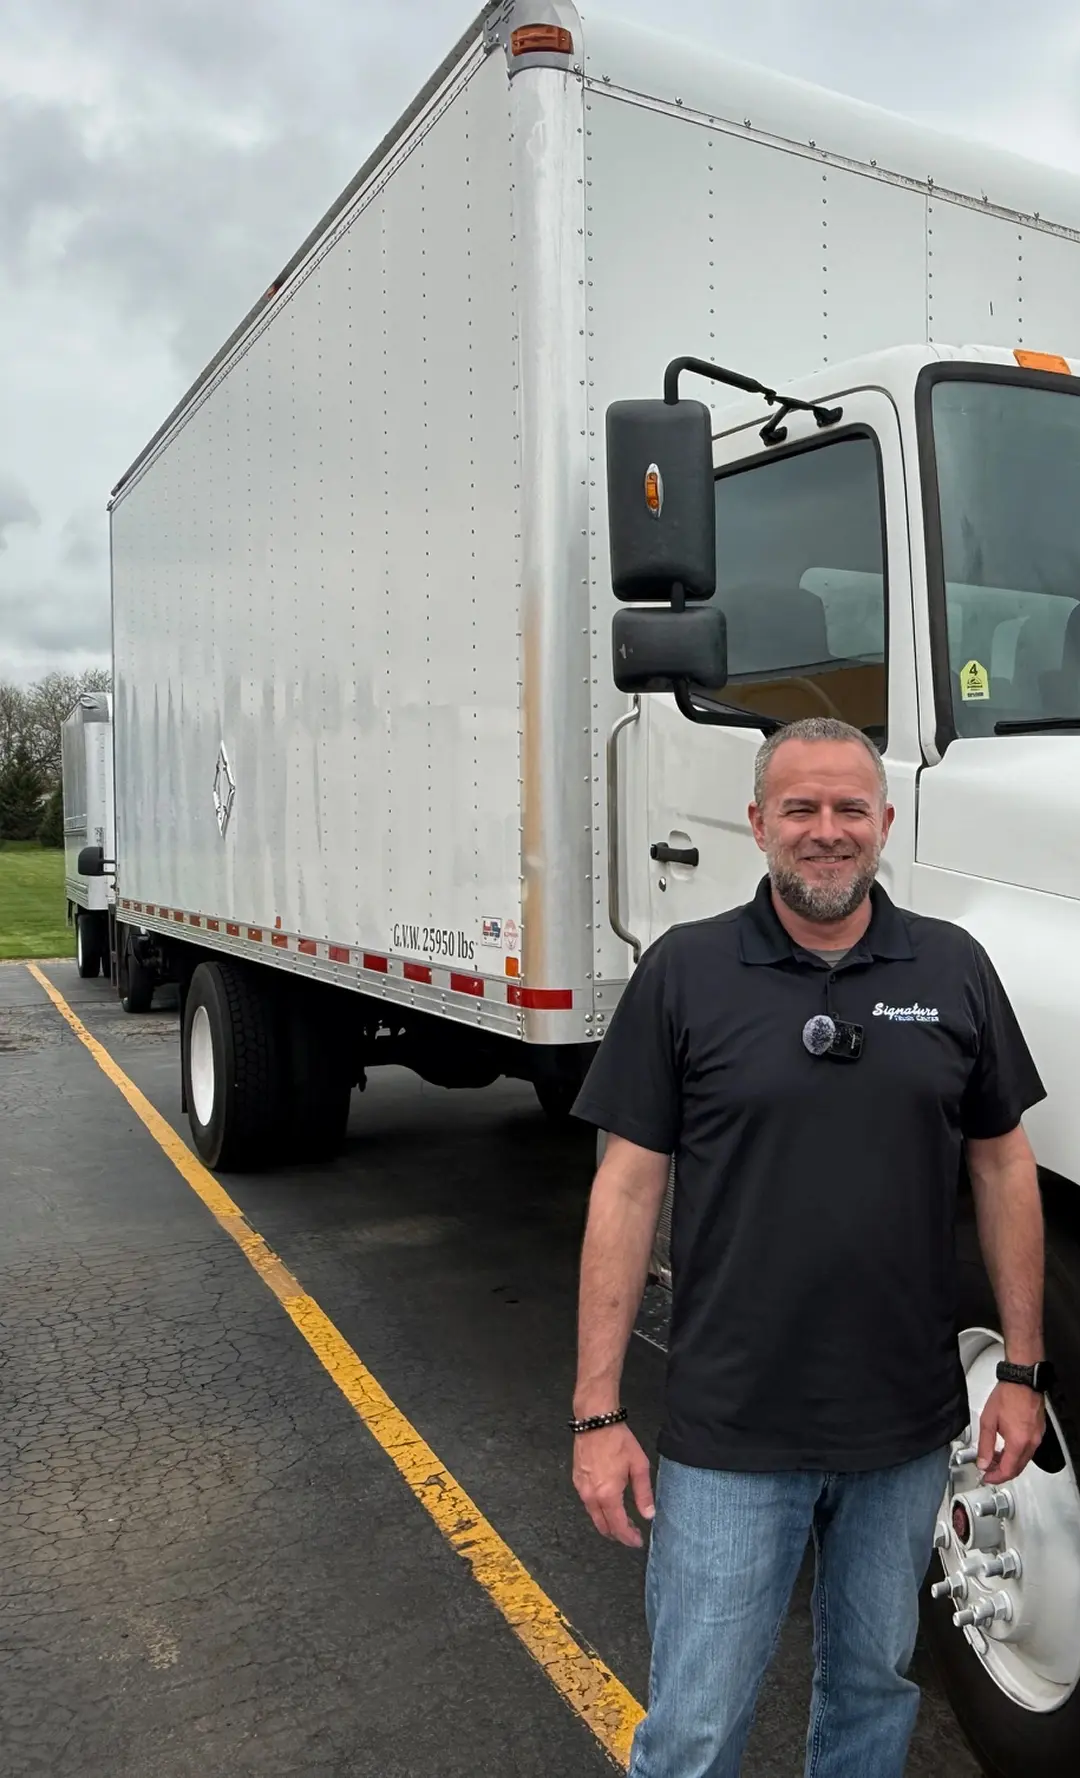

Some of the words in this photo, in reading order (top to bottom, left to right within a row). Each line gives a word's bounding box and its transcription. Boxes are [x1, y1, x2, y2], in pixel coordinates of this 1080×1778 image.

[969, 663, 978, 676] 4
[393, 923, 420, 950] G.V.W.
[422, 927, 455, 957] 25950
[457, 931, 474, 960] lbs
[872, 1002, 939, 1020] Signature
